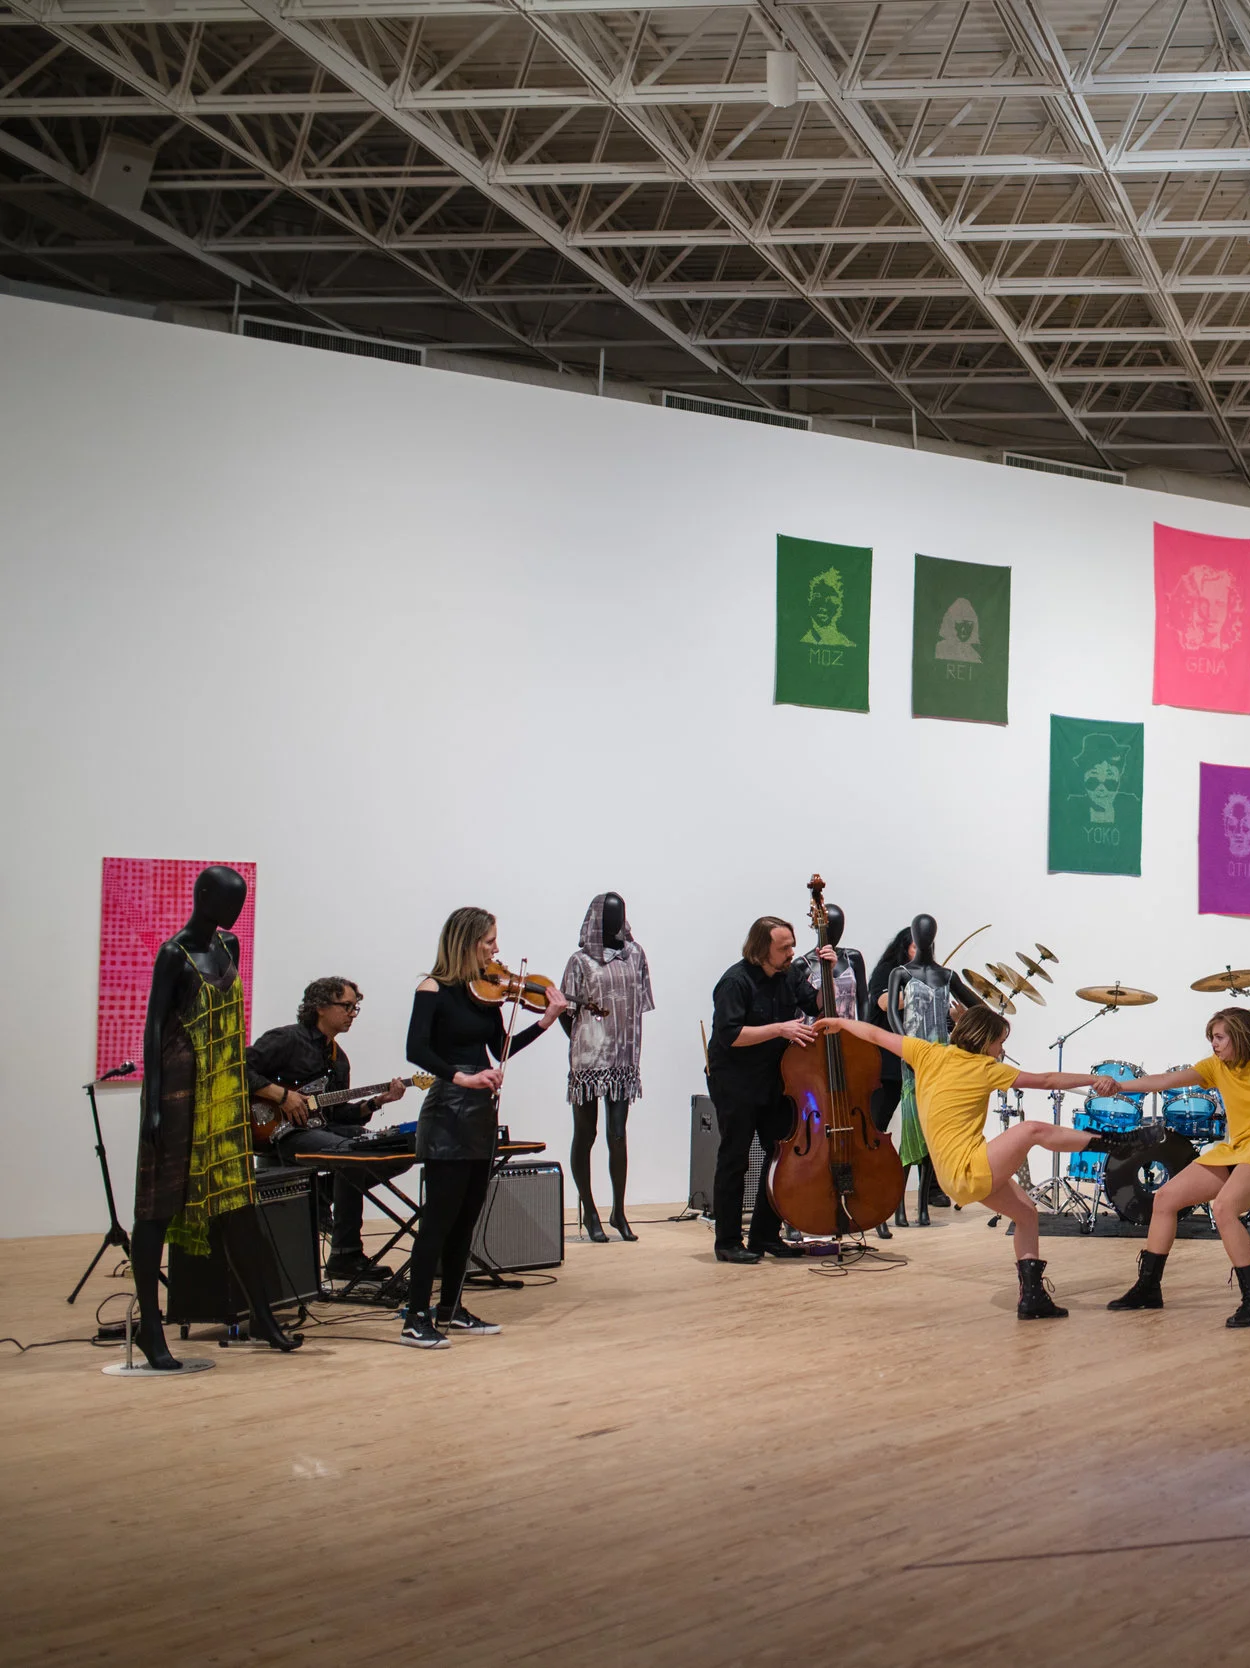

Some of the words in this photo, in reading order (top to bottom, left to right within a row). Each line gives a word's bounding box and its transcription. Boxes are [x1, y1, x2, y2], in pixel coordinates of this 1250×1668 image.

[809, 648, 844, 666] MOZ
[1186, 656, 1228, 675] GENA
[946, 663, 973, 681] REI
[1083, 826, 1120, 846] YOKO
